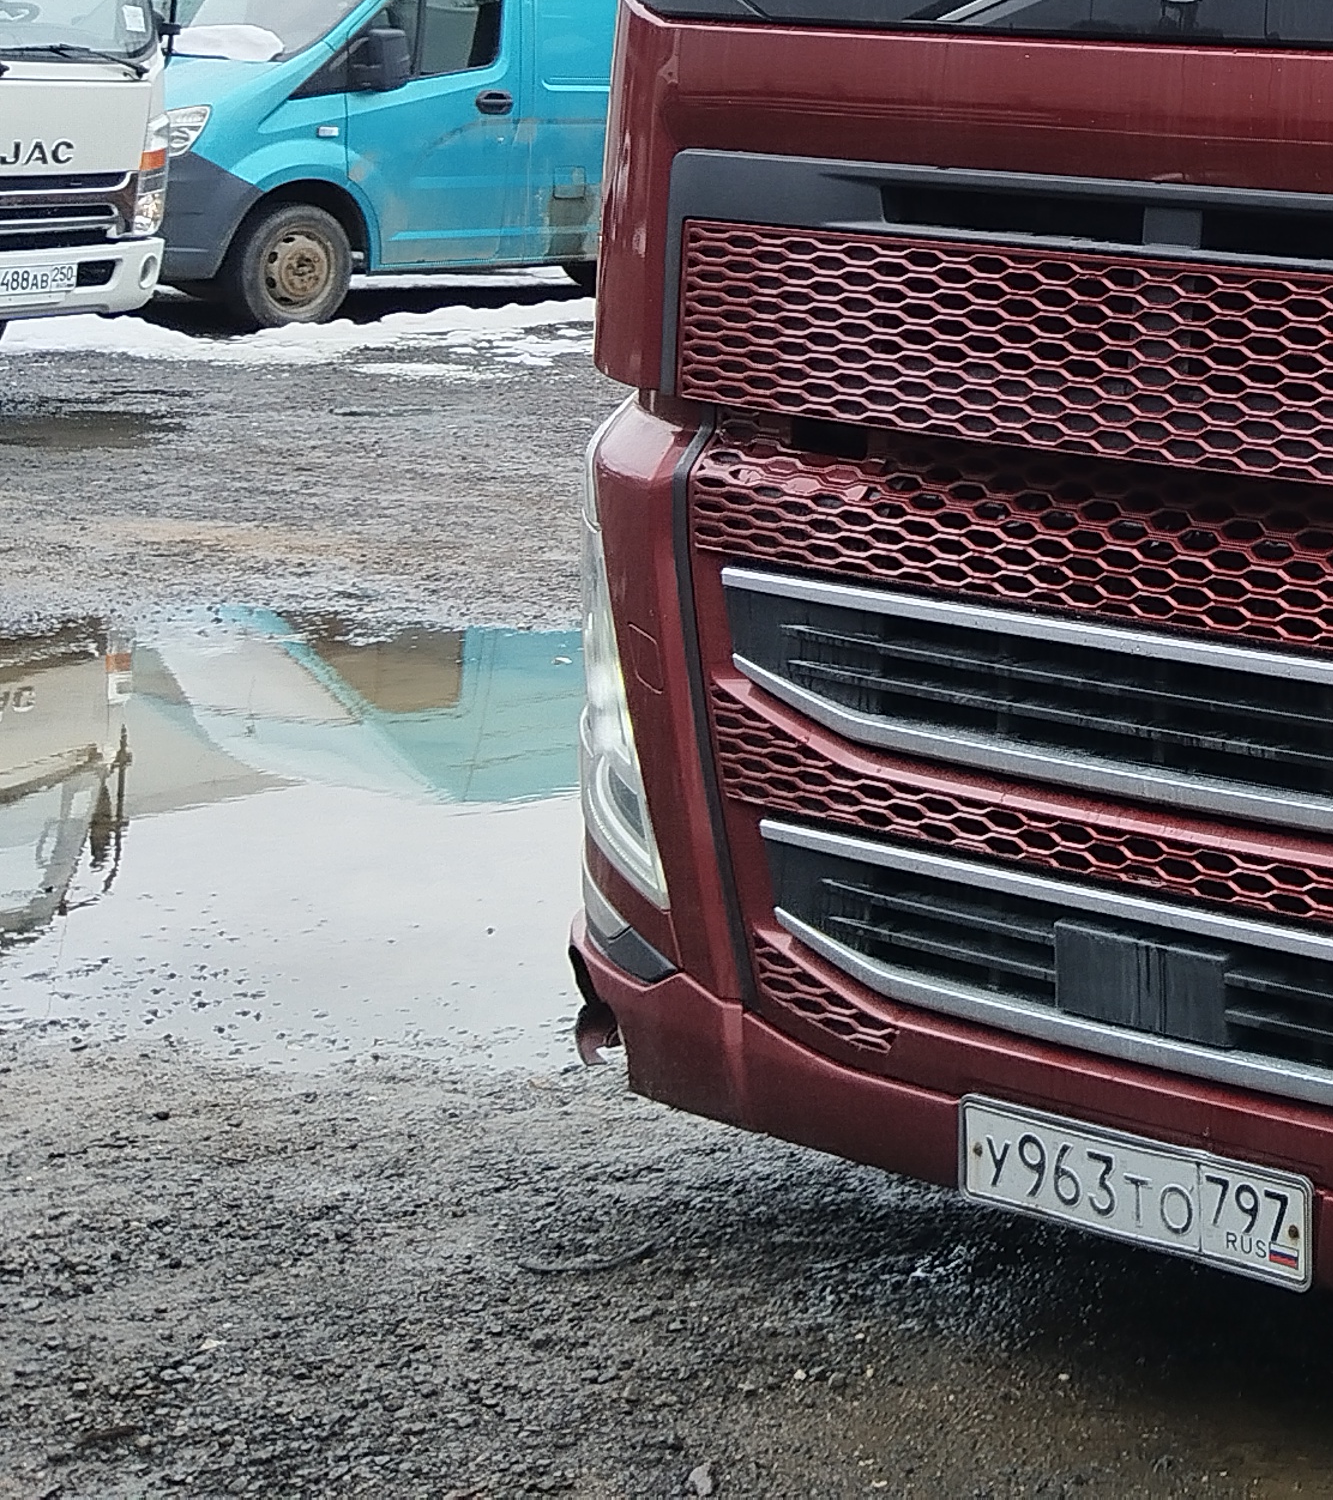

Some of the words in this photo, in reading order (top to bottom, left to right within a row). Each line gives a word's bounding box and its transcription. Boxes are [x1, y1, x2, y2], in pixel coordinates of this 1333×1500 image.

[0, 140, 75, 166] JAC
[51, 265, 74, 282] 250
[1204, 1173, 1290, 1244] 797
[1225, 1230, 1267, 1259] RUS
